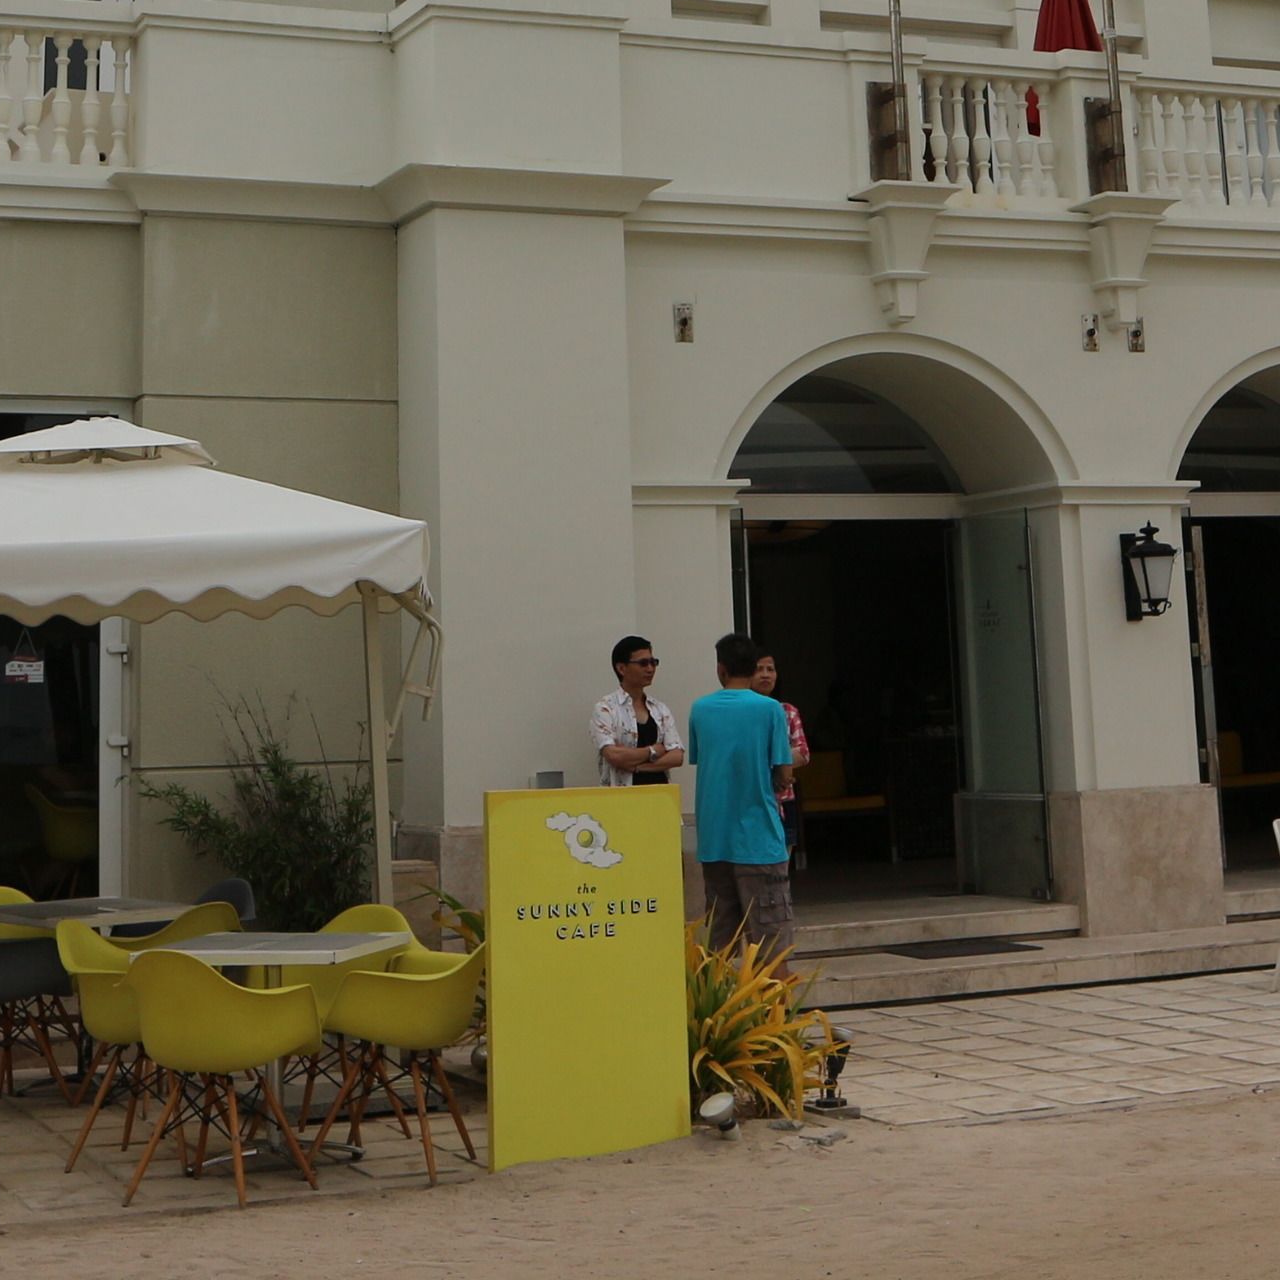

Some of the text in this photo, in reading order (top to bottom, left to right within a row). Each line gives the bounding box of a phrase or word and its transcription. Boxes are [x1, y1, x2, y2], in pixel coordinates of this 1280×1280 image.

[577, 882, 597, 895] the
[517, 898, 658, 920] SUNNY SIDE
[556, 922, 616, 939] CAFE
